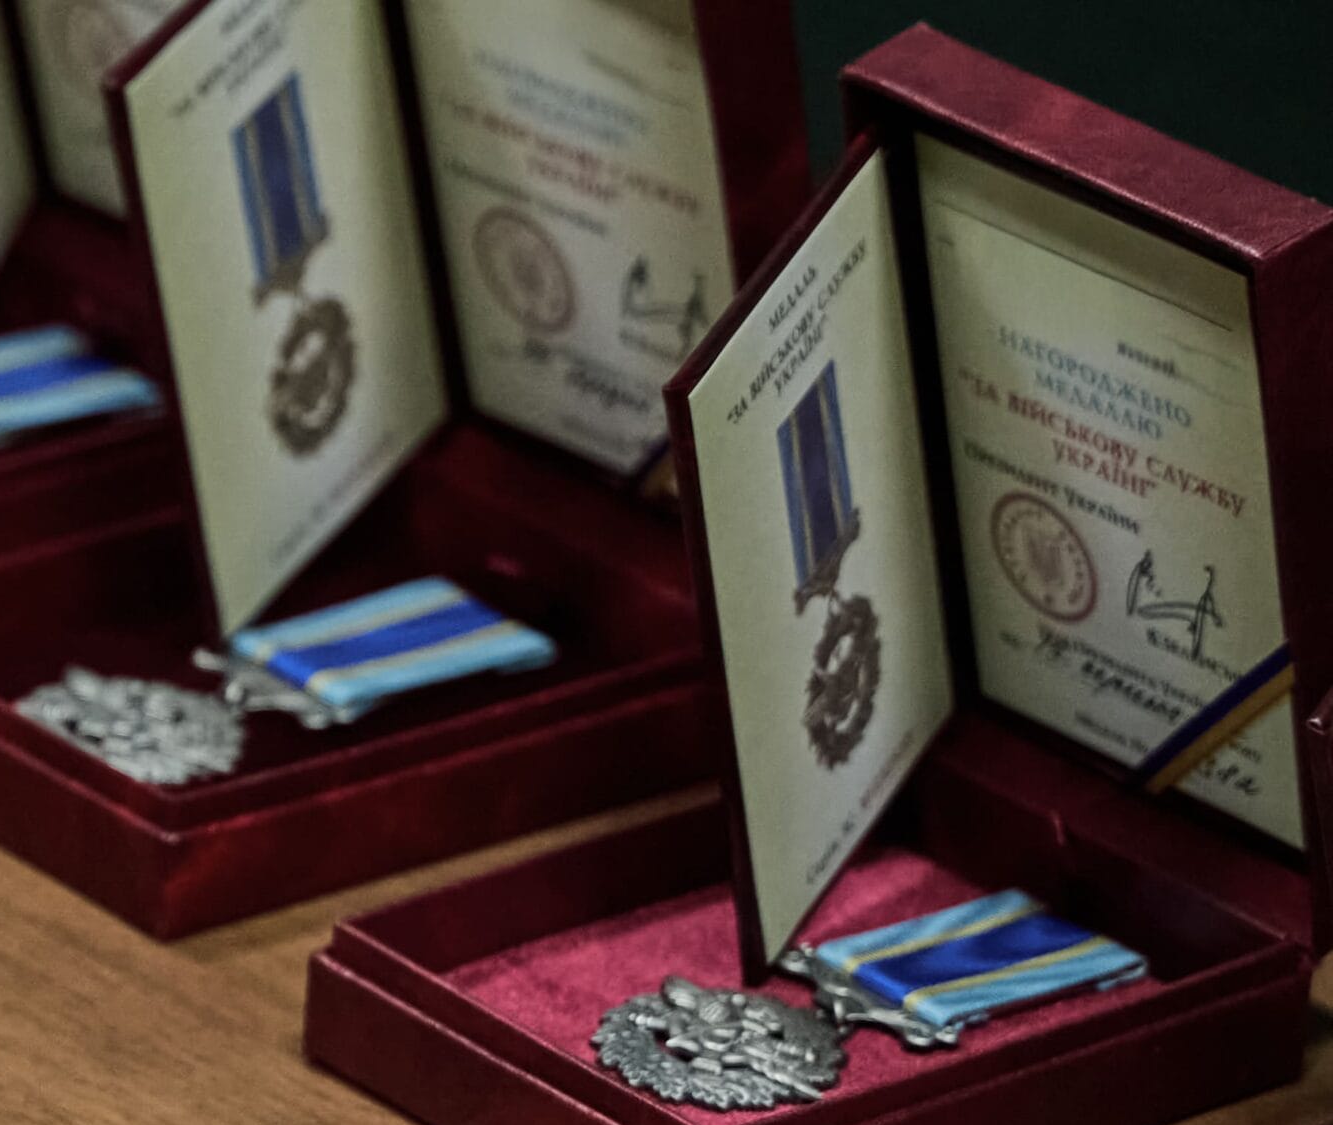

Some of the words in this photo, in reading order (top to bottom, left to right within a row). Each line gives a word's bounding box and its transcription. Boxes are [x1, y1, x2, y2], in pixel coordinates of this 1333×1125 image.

[997, 324, 1193, 429] НАГОРОДЖЕНО
[1007, 390, 1139, 467] ВІЙСЬКОВУ
[1144, 454, 1249, 519] СЛУЖБУ
